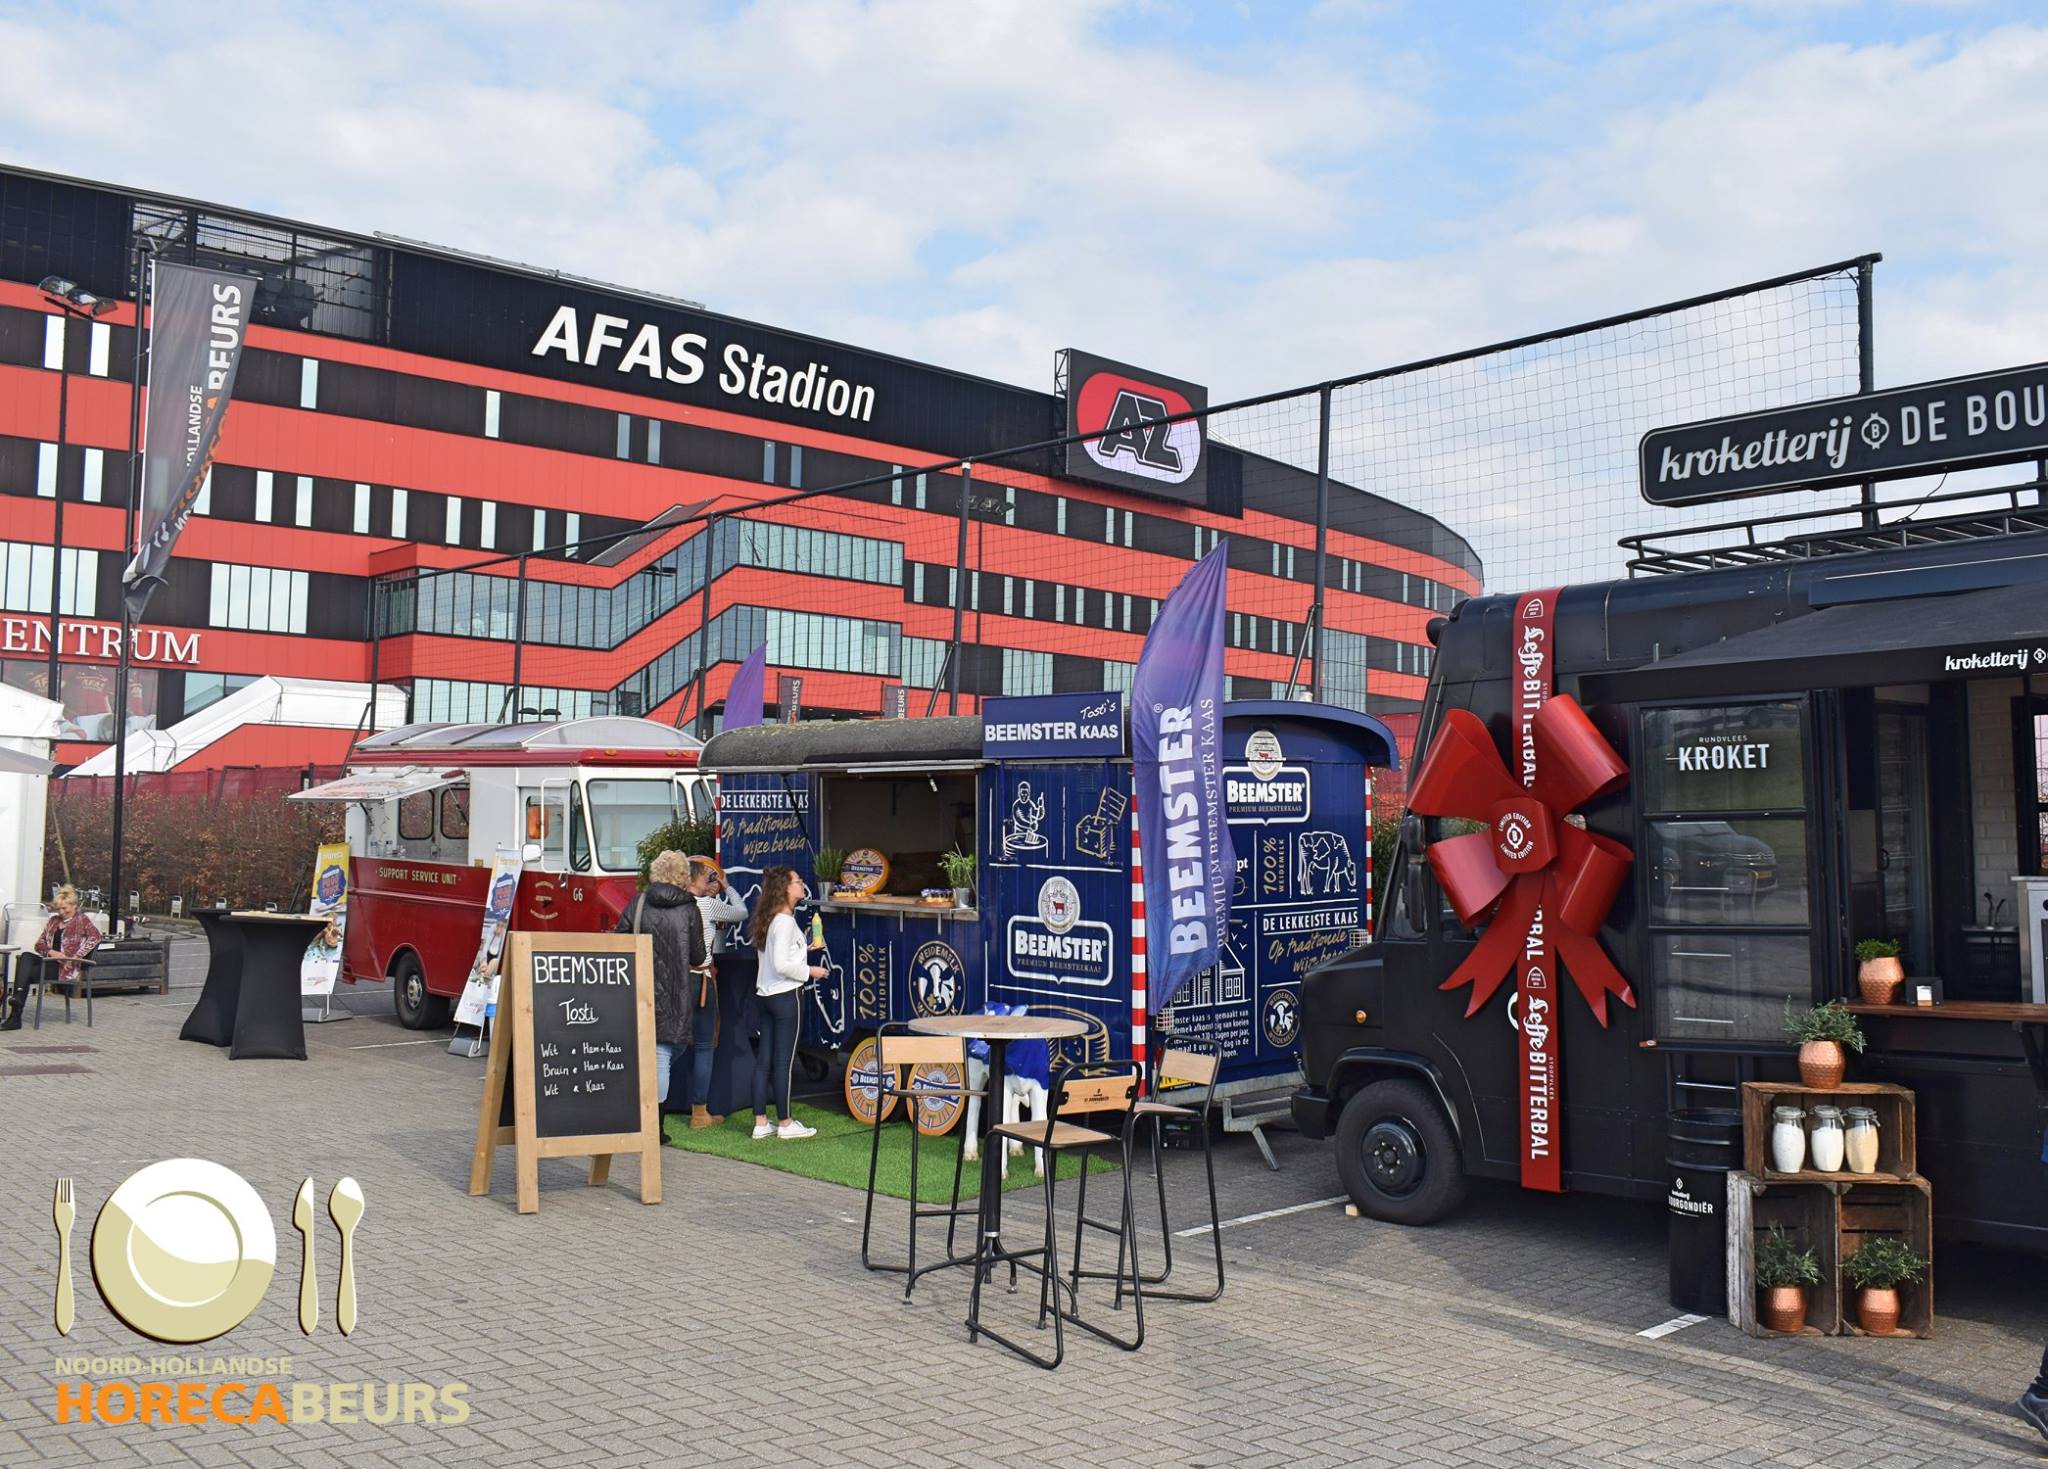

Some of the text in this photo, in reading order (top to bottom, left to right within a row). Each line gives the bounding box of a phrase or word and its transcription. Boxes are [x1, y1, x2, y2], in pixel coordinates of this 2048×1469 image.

[532, 305, 876, 422] AFAS Stadion
[187, 385, 203, 468] OLLANDSE
[1098, 388, 1182, 473] AZ
[1658, 416, 1852, 483] kroketterij
[1901, 400, 1947, 446] DE
[1966, 384, 2046, 436] BOU
[1518, 625, 1545, 680] Leffe
[1944, 649, 2029, 671] kroketterij
[1080, 699, 1117, 720] Tosti's
[985, 722, 1119, 742] BEEMSTER KAAS
[1698, 735, 1748, 743] RUNDVLEES
[1678, 744, 1770, 771] KROKET
[1226, 779, 1303, 803] BEEMSTER
[1158, 703, 1208, 955] BEEMSTER
[1200, 698, 1228, 949] PREMIUM BEEMSTER KAAS
[379, 867, 457, 885] SUPPORT SERVICE UNIT
[1263, 837, 1278, 895] 100%
[1263, 919, 1275, 932] DE
[1334, 911, 1358, 925] KAAS
[918, 946, 960, 974] WEIDEMELK
[1015, 930, 1102, 962] BEEMSTER
[534, 956, 631, 986] BEEMSTER
[859, 943, 877, 1019] 100%
[558, 998, 599, 1026] Tosti
[1523, 995, 1549, 1051] Leffe
[540, 1043, 559, 1058] Wit
[543, 1063, 569, 1078] Bruin
[543, 1083, 560, 1097] Wit
[585, 1080, 605, 1093] Kaas
[1529, 1051, 1549, 1160] BITTERBAL
